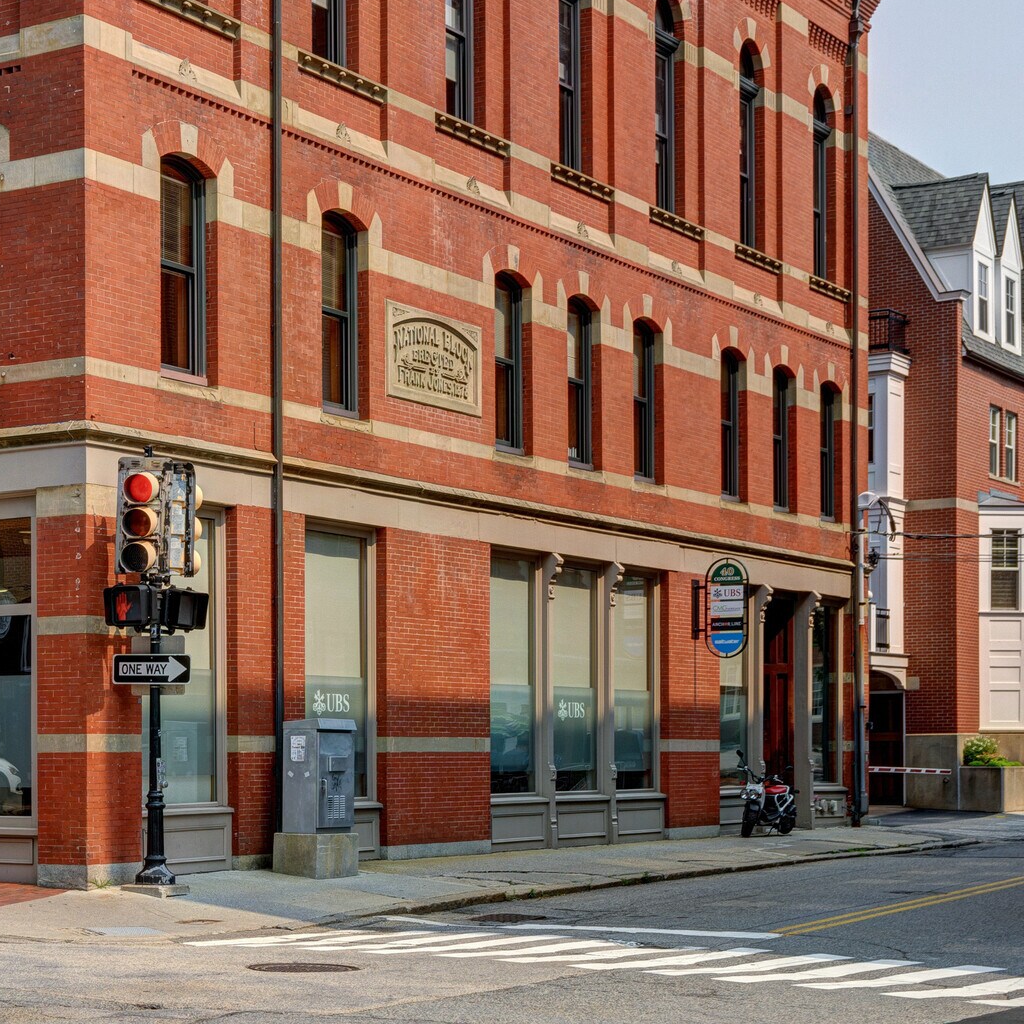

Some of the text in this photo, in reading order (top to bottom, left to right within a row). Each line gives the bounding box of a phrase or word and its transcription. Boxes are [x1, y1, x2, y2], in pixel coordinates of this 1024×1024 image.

[393, 325, 473, 378] NATIONAL BLOCK
[412, 349, 455, 372] ERECTED
[397, 365, 425, 388] FRANK
[720, 567, 735, 576] 40
[723, 588, 741, 597] UBS
[121, 663, 168, 675] ONE WAY
[327, 693, 350, 713] UBS
[568, 701, 585, 719] UBS
